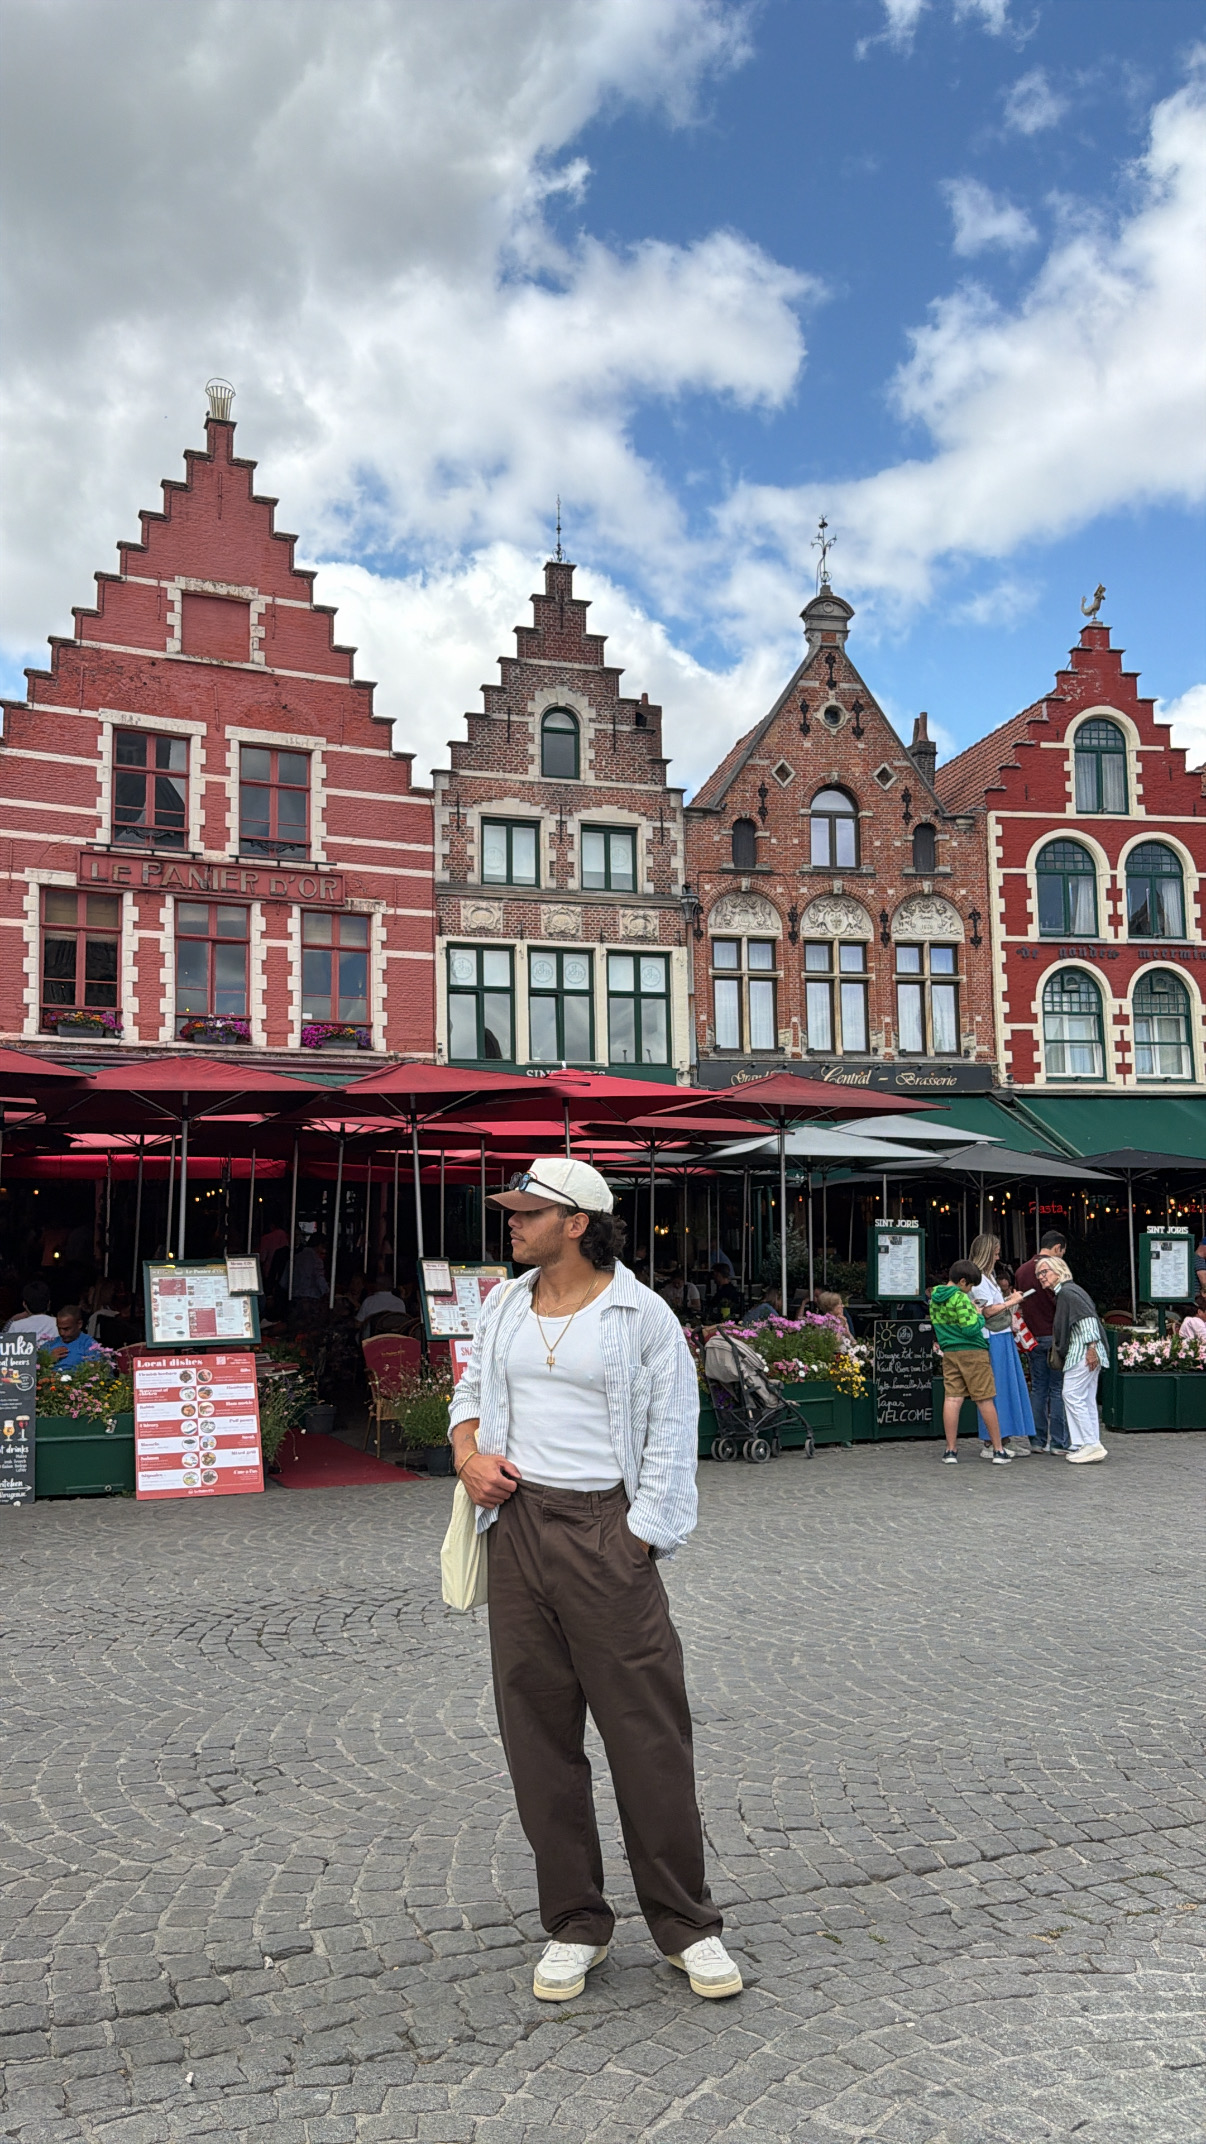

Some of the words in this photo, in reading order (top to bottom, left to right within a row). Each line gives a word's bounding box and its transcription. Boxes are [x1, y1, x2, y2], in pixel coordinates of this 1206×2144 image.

[91, 861, 131, 884] LE
[142, 861, 259, 895] PANIER
[269, 874, 338, 900] D'OR
[730, 1070, 769, 1086] Gra
[896, 1072, 957, 1086] Brasserie
[874, 1218, 894, 1227] SINT
[896, 1219, 919, 1228] JORIS
[1146, 1225, 1165, 1234] SINT
[1167, 1225, 1189, 1234] JORIS
[137, 1358, 166, 1368] Local
[169, 1357, 203, 1367] dishes
[877, 1393, 905, 1411] Tapas
[877, 1408, 933, 1424] WELCOME
